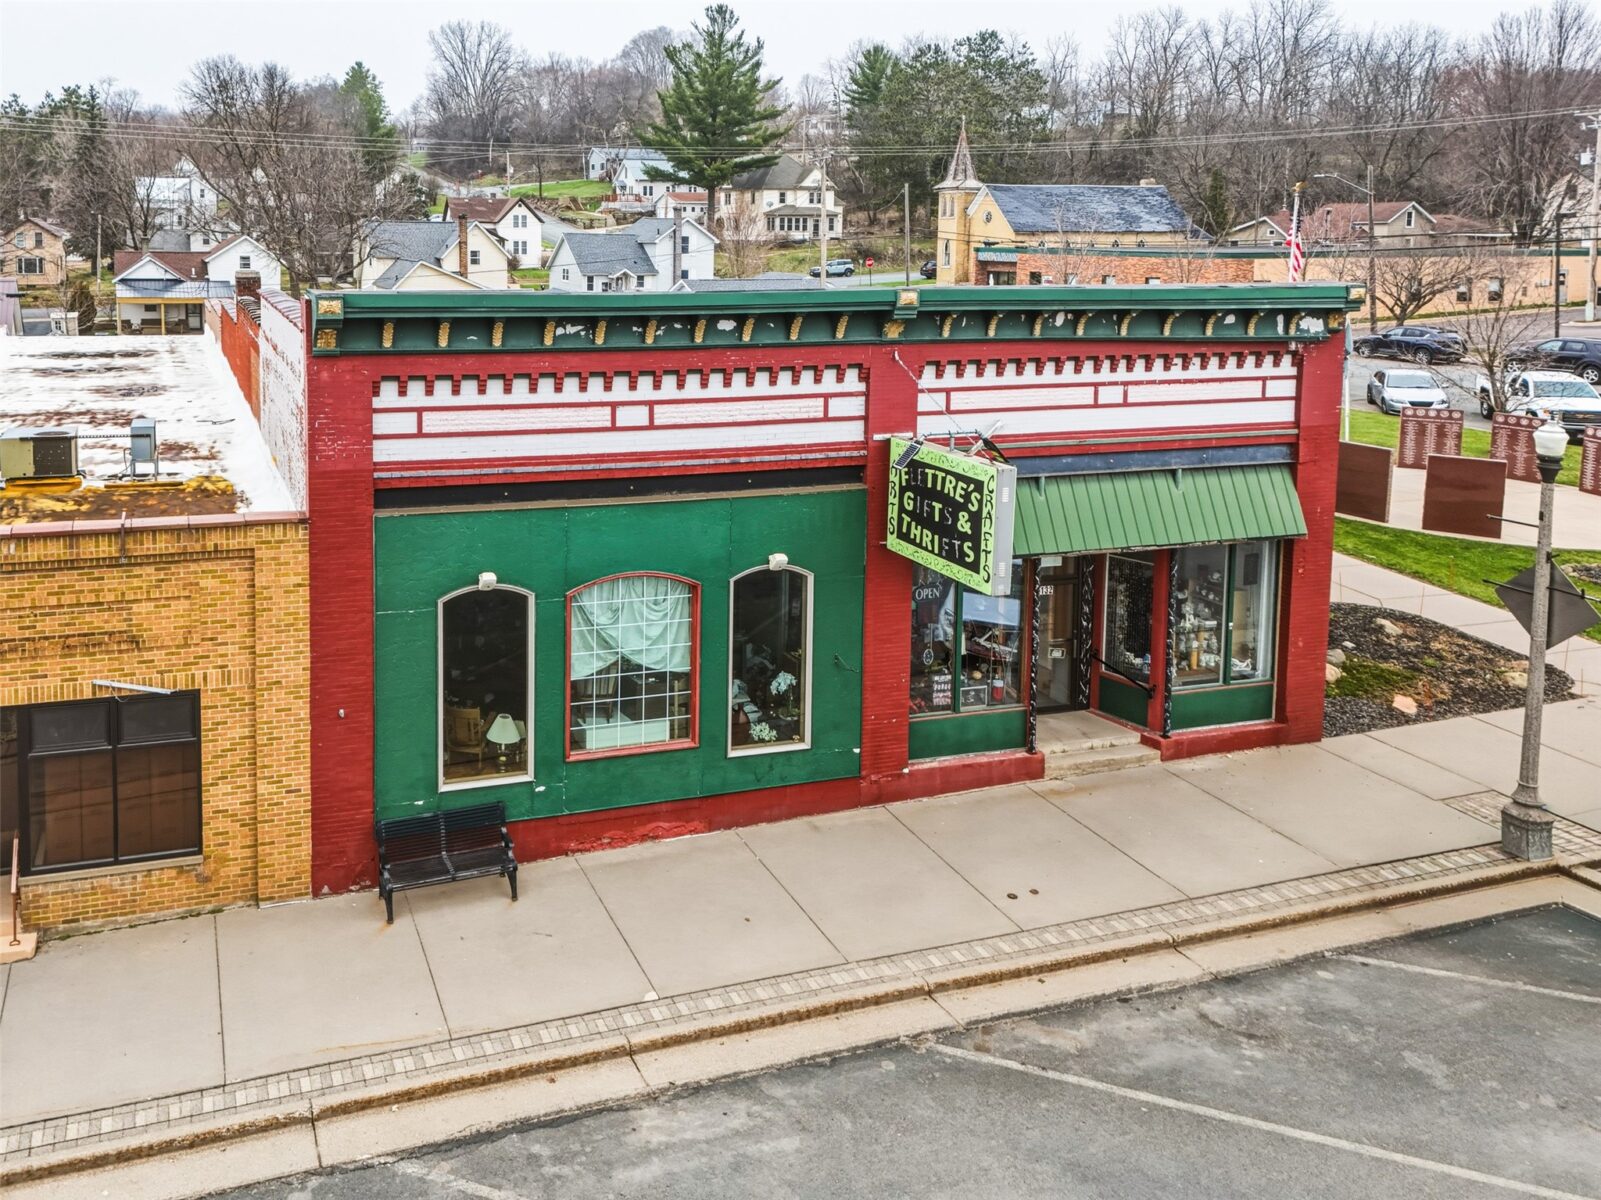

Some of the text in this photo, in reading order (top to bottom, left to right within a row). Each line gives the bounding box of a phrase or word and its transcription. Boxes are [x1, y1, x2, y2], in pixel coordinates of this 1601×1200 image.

[901, 467, 982, 512] FLETTRE'S
[903, 492, 972, 535] GIFTS &
[982, 475, 995, 583] CRAFTS
[902, 514, 975, 563] THRIFTS
[915, 587, 940, 600] OPEN
